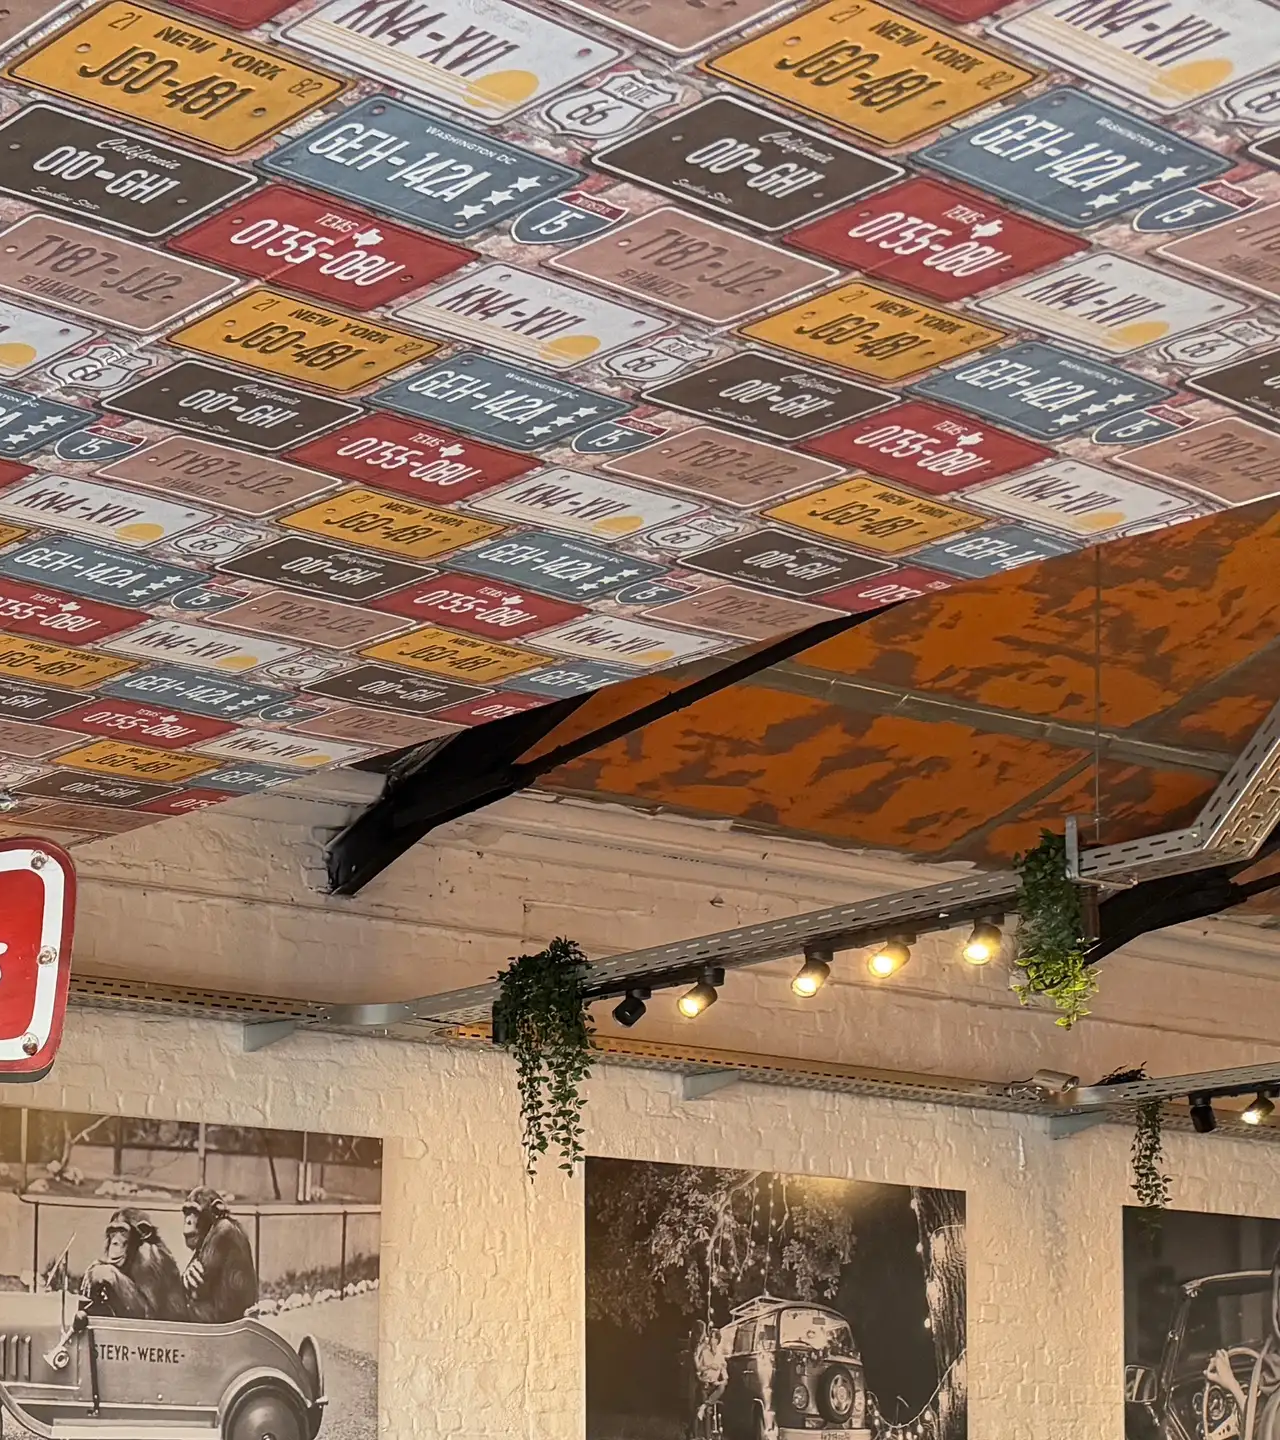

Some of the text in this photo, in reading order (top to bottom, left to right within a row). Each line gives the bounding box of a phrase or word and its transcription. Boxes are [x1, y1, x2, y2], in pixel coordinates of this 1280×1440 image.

[149, 28, 287, 83] NEW YORK
[555, 103, 627, 126] 66
[302, 123, 497, 201] GEH-142A
[971, 114, 1134, 188] GEH-142A
[523, 209, 593, 234] 15
[401, 370, 562, 425] GEH-142A
